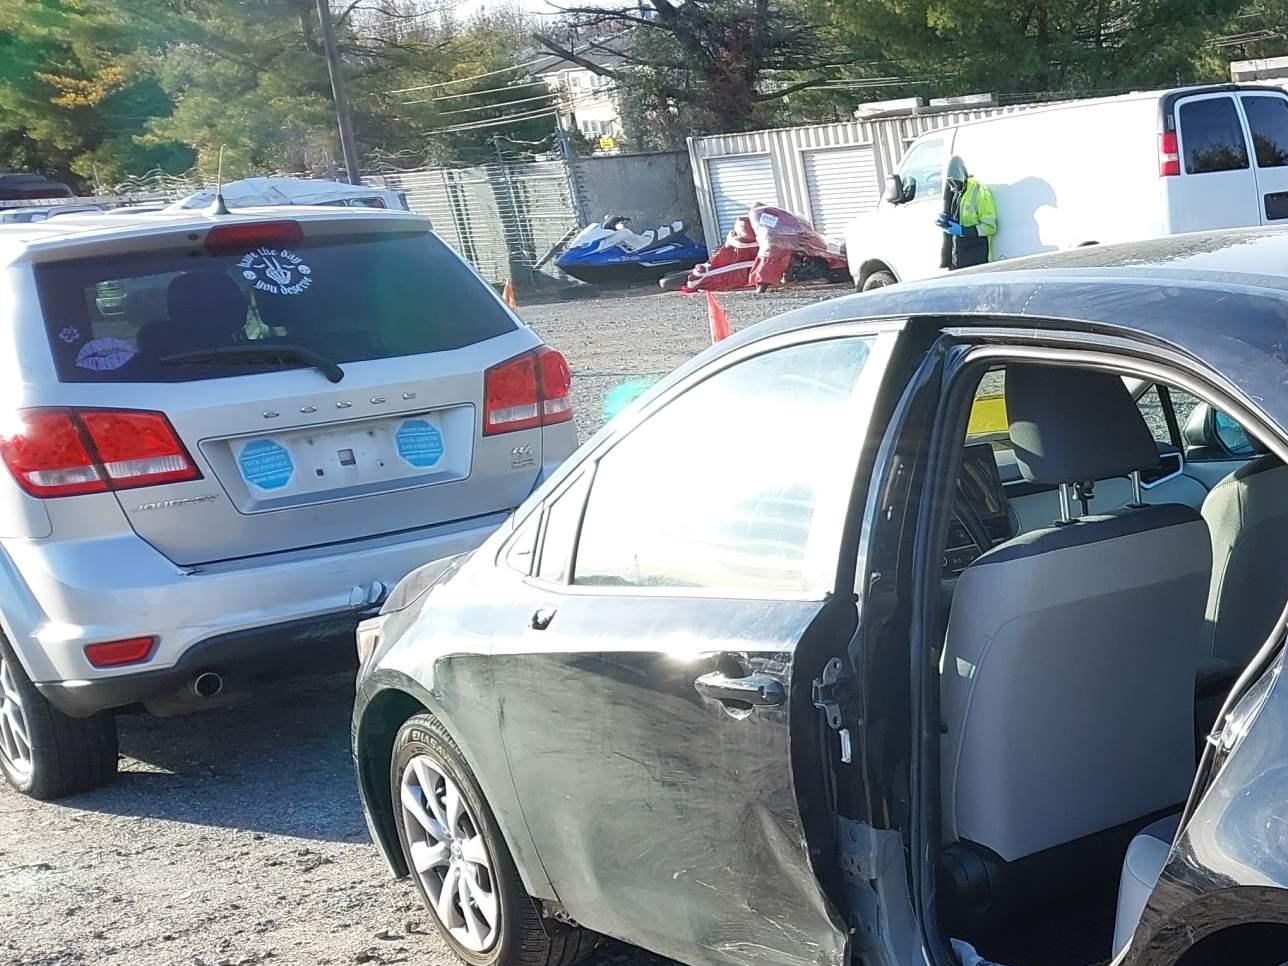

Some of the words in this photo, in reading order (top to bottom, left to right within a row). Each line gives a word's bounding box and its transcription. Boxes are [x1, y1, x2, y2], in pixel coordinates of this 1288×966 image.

[236, 252, 259, 268] have
[257, 246, 277, 257] the
[280, 249, 303, 264] day
[253, 279, 278, 294] you
[280, 276, 313, 296] deserve
[263, 391, 417, 419] DODGE
